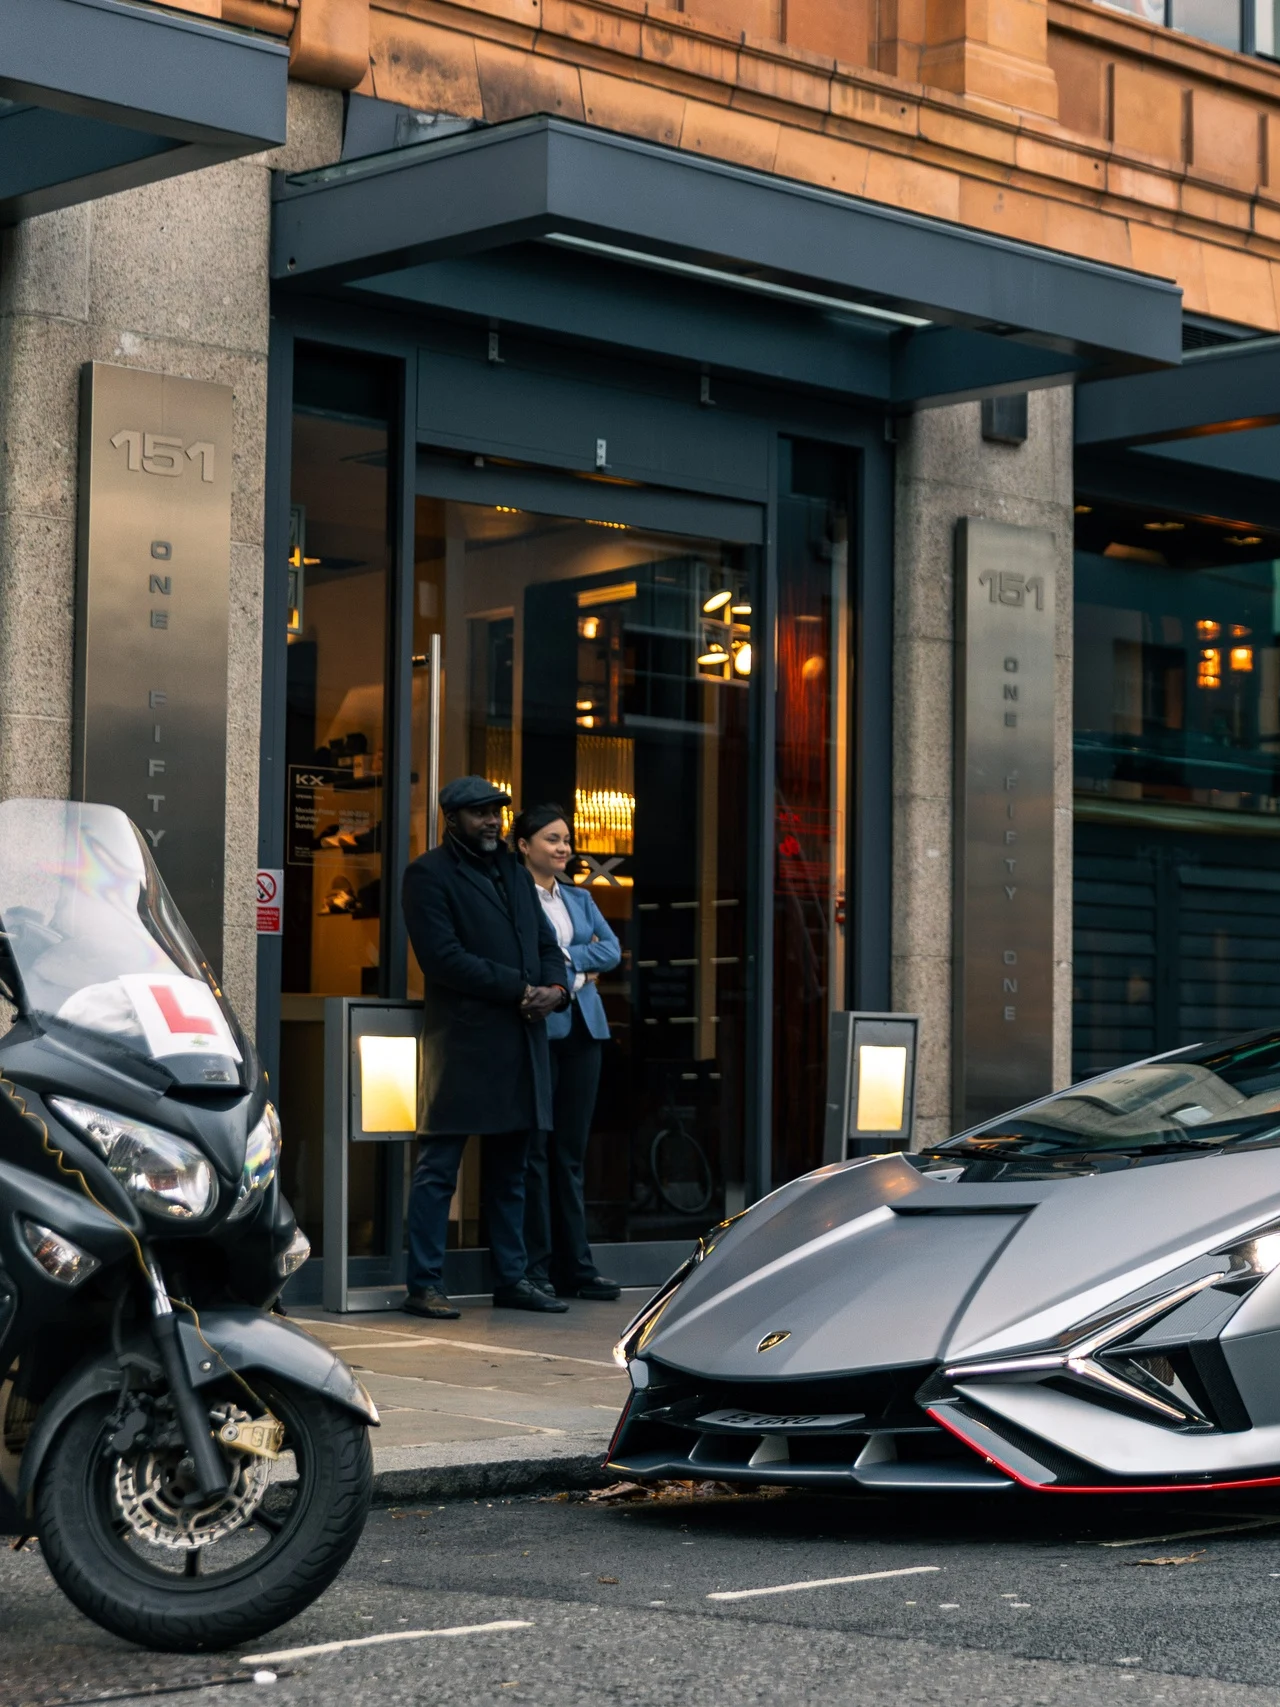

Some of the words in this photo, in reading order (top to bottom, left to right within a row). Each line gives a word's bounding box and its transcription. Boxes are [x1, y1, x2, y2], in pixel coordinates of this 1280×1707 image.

[110, 429, 214, 483] 151
[149, 540, 172, 629] ONE
[979, 568, 1044, 610] 151
[1003, 657, 1018, 727] ONE
[147, 690, 166, 848] FIFTY
[295, 774, 324, 786] KX
[1004, 776, 1018, 901] FIFTY
[148, 985, 218, 1036] L
[1004, 950, 1018, 1021] ONE
